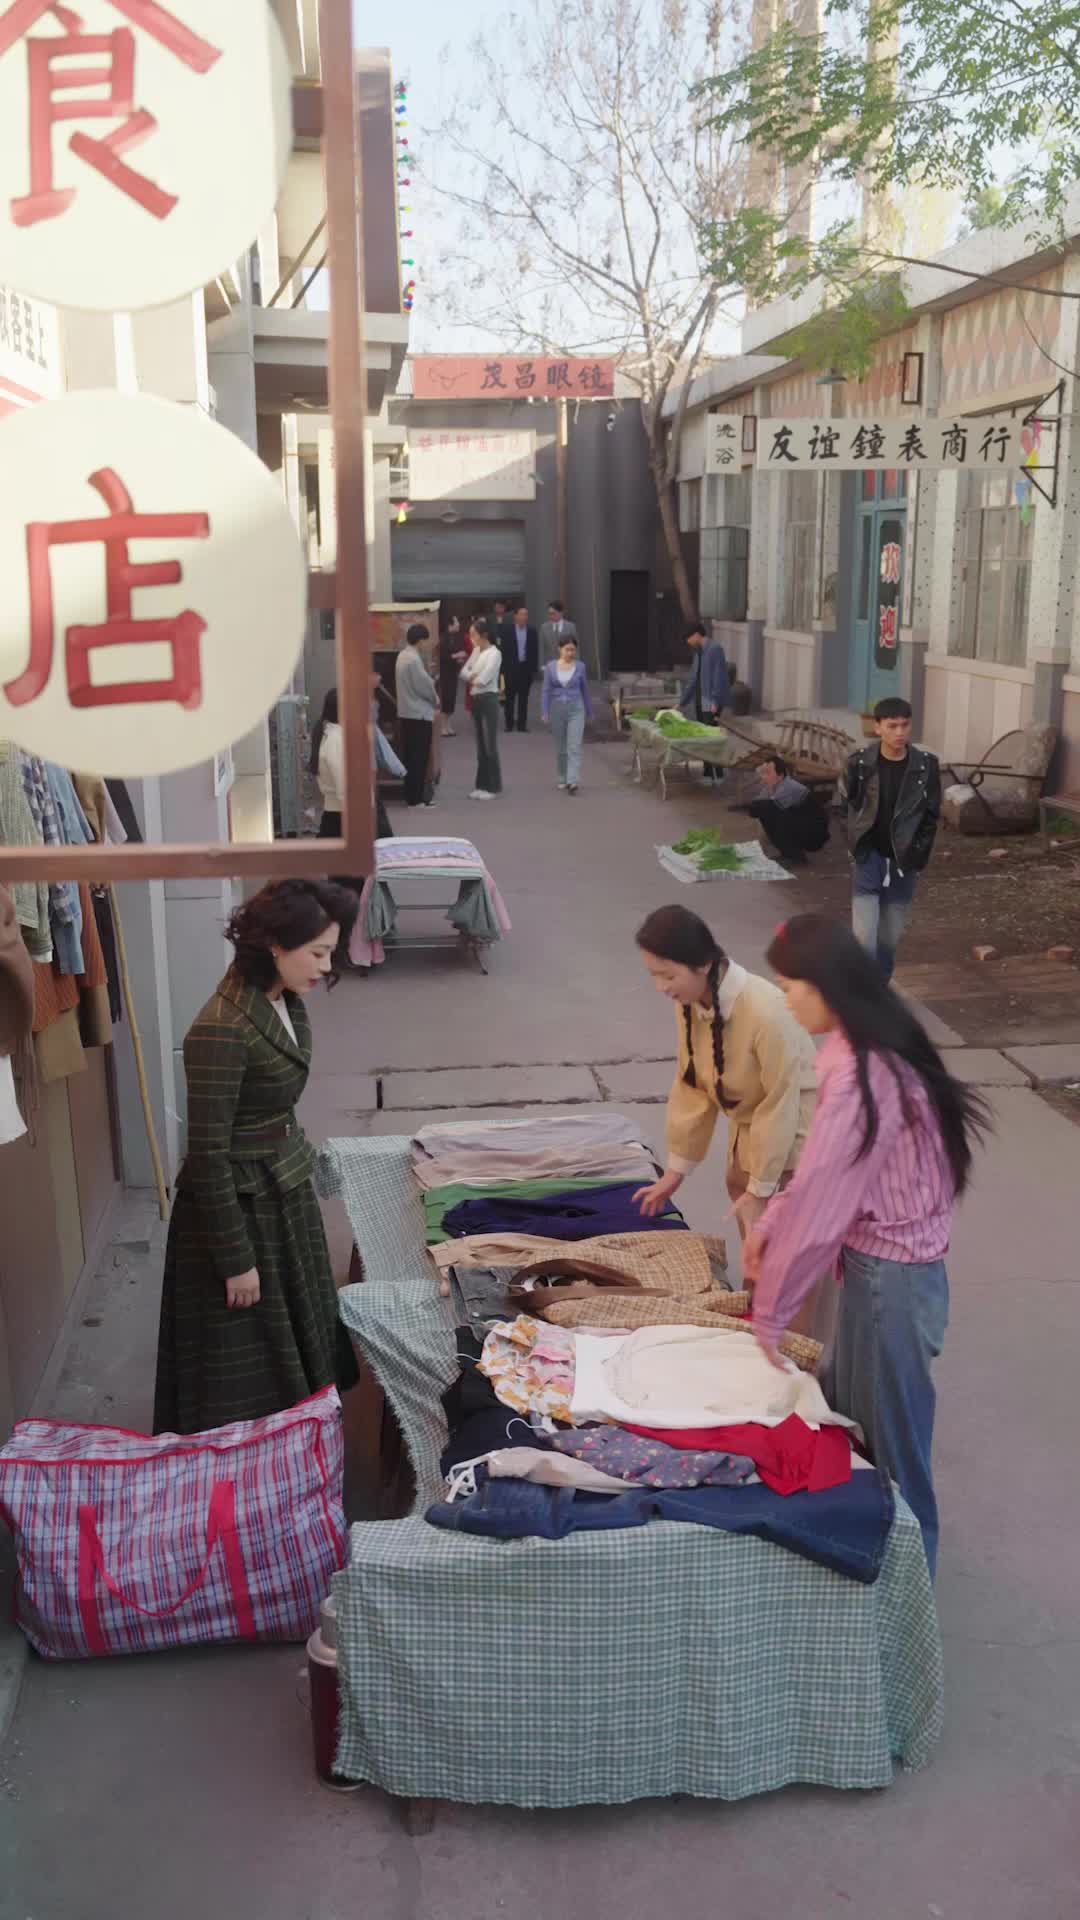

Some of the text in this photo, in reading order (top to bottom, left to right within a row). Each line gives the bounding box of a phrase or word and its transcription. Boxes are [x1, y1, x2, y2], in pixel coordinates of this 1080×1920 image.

[480, 362, 608, 391] 茂昌眼镜
[716, 423, 736, 465] 洗浴
[768, 423, 1012, 462] 友谊鐘表商行
[879, 542, 901, 649] 欢迎
